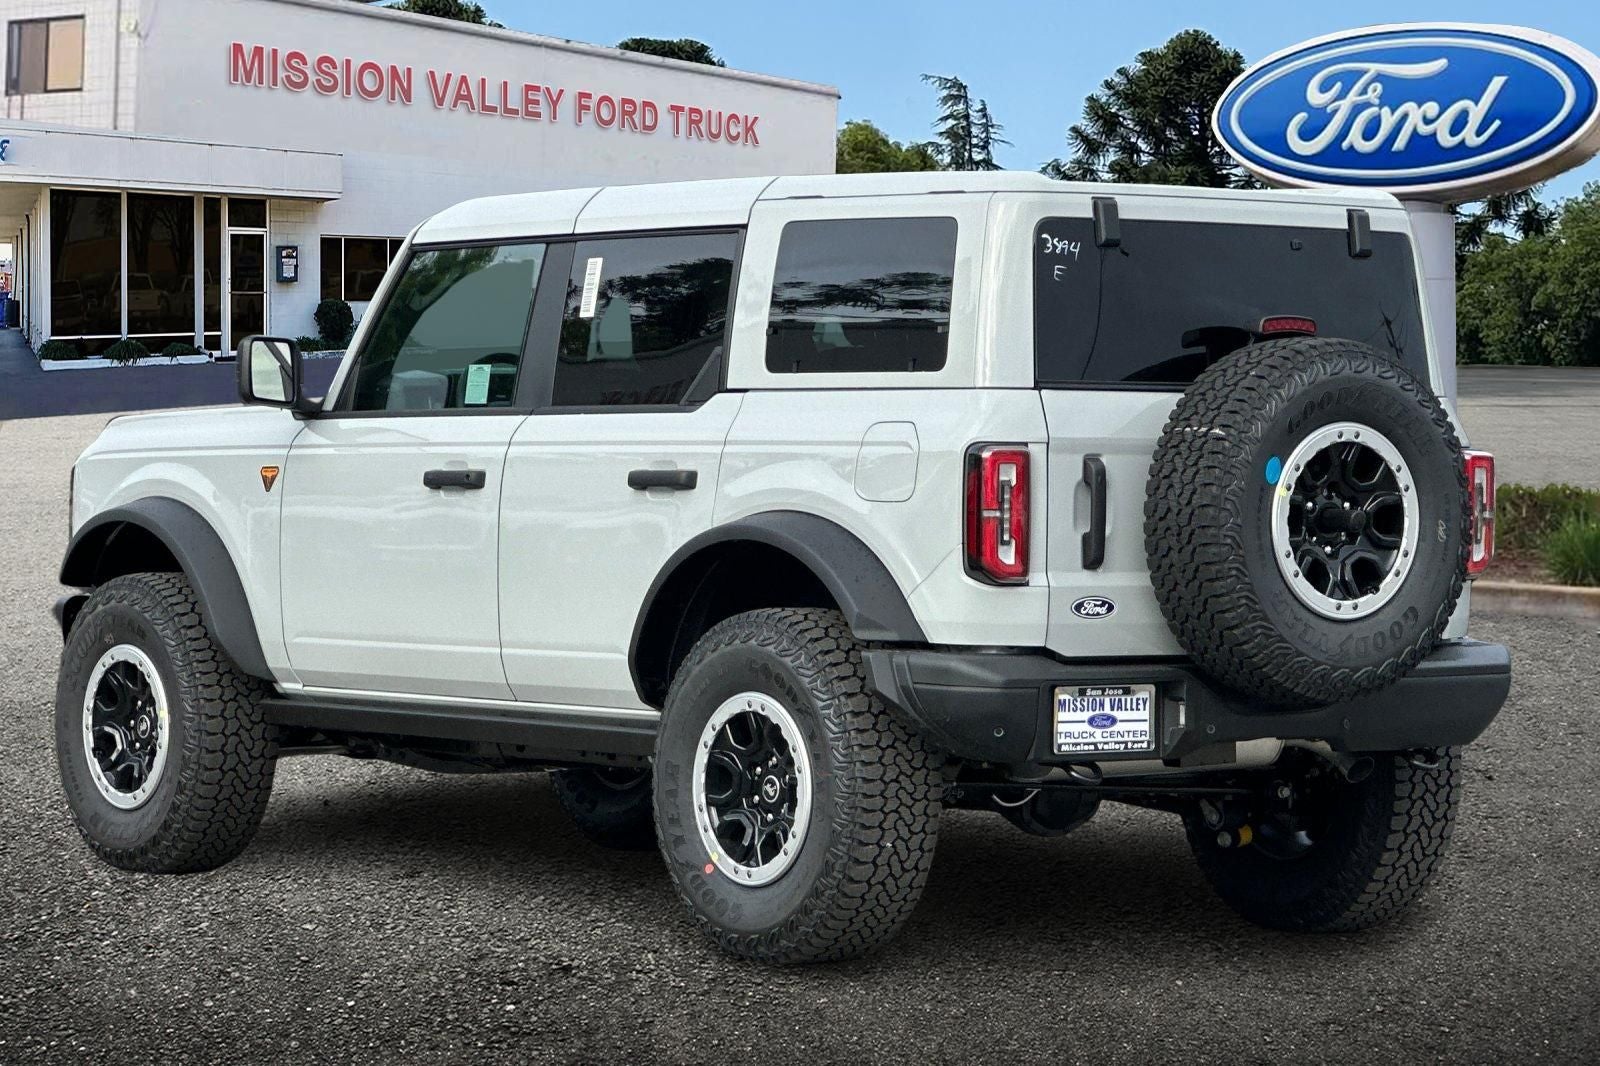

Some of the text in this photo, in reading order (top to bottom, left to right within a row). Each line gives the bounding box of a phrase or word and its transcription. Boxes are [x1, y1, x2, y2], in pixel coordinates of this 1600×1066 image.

[230, 41, 760, 146] MISSION VALLEY FORD TRUCK
[1286, 57, 1509, 156] Ford
[1041, 233, 1080, 261] 3894
[1080, 600, 1109, 615] Ford
[1104, 687, 1123, 696] Jose
[1058, 697, 1148, 713] MISSION VALLEY
[1092, 715, 1113, 727] Ford
[1057, 730, 1148, 740] TRUCK CENTER
[1097, 742, 1125, 751] Valley
